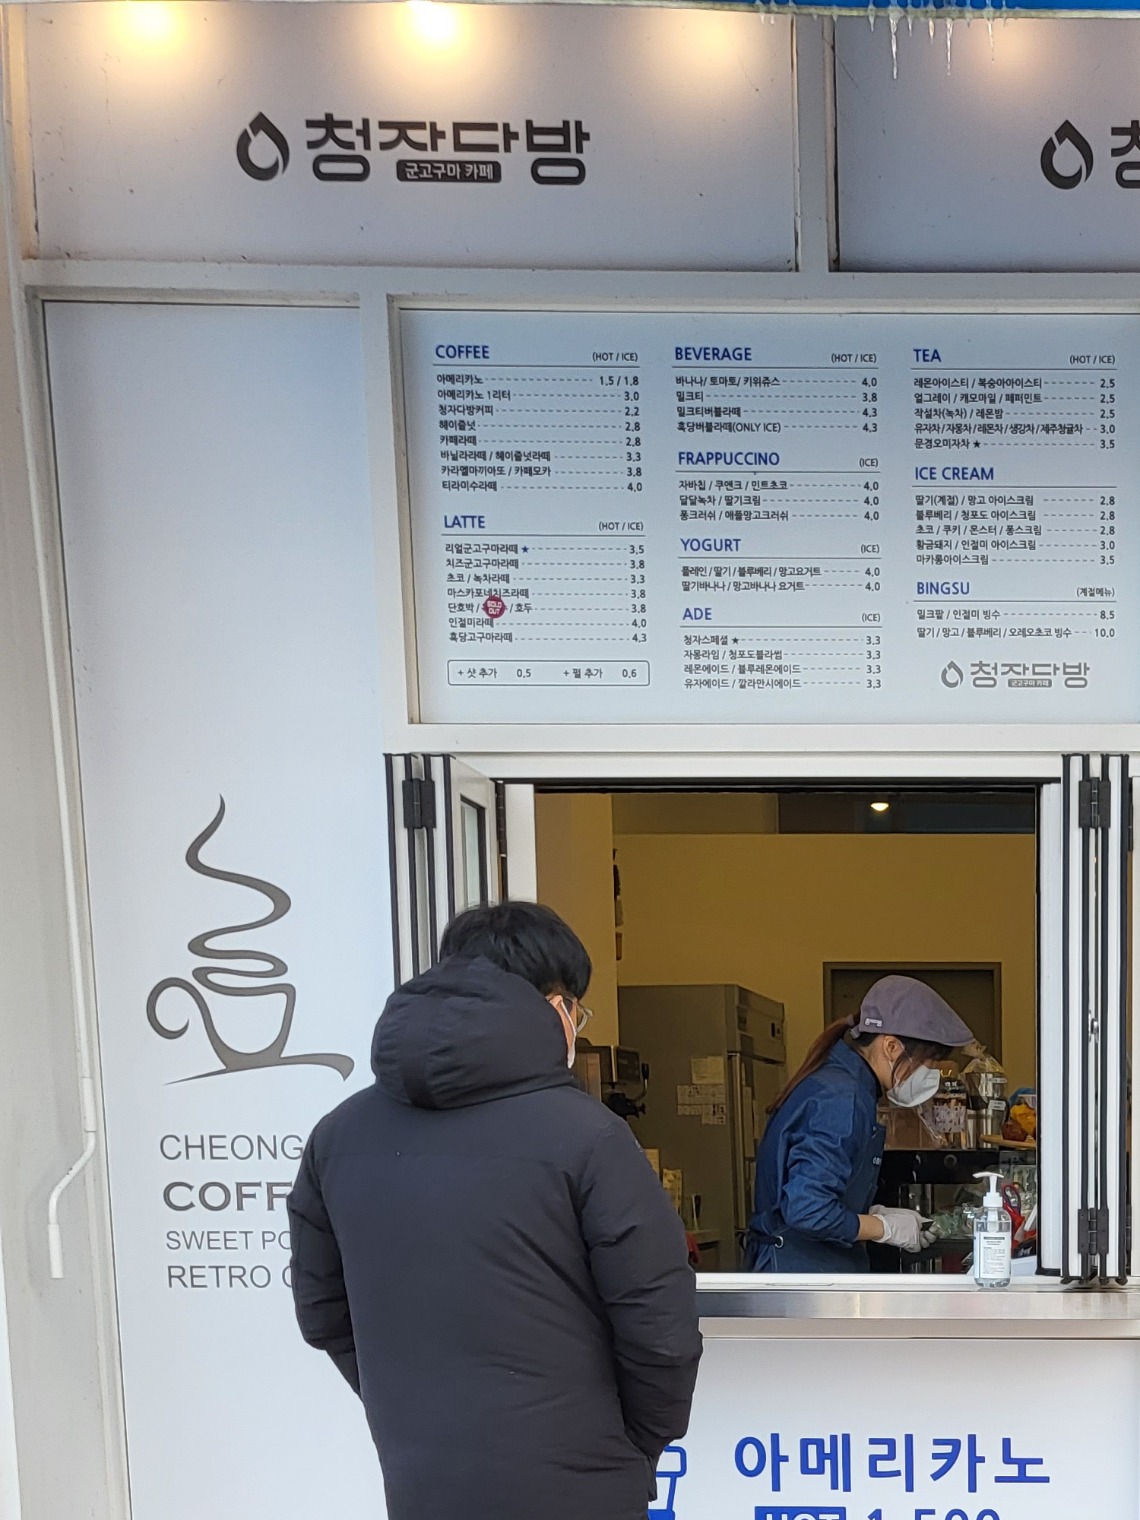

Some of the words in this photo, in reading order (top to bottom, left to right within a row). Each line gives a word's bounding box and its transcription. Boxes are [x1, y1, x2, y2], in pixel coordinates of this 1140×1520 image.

[304, 113, 590, 186] 청자다방
[404, 163, 461, 180] 군고구마
[464, 163, 494, 181] 카페
[435, 345, 489, 359] COFFEE
[675, 347, 752, 361] BEVERAGE
[913, 348, 941, 362] TEA
[436, 374, 483, 385] 아메리카노
[599, 376, 614, 386] 1.5
[624, 376, 639, 386] 1.8
[914, 378, 968, 388] 레몬아이스티
[978, 378, 1042, 388] 복숭아아이스티
[1100, 378, 1115, 389] 2.5
[437, 389, 483, 400] 아메리카노
[487, 389, 510, 401] 1리터
[624, 391, 639, 401] 3.0
[676, 391, 704, 402] 밀크티
[862, 393, 877, 403] 3.8
[914, 393, 950, 404] 얼그레이
[959, 393, 996, 404] 캐모마일
[1005, 393, 1042, 404] 페퍼민트
[1100, 394, 1115, 404] 2.5
[438, 405, 493, 415] 청자다방커피
[624, 407, 639, 416] 2.2
[676, 406, 741, 418] 밀크티버블라떼
[862, 408, 877, 418] 4.3
[625, 422, 640, 432] 2.8
[439, 435, 476, 446] 카페라떼
[625, 437, 641, 447] 2.8
[915, 438, 969, 449] 문경오미자차
[1100, 439, 1115, 449] 3.5
[440, 450, 486, 461] 바닐라라떼
[626, 452, 641, 462] 3.3
[678, 451, 779, 465] FRAPPUCCINO
[859, 457, 878, 468] (ICE)
[915, 467, 936, 480] ICE
[942, 467, 994, 480] CREAM
[441, 480, 497, 491] 티라미수라떼
[627, 482, 642, 492] 4.0
[678, 480, 706, 491] 자바칩
[714, 481, 742, 490] 쿠앤크
[751, 480, 788, 490] 민트초코
[863, 481, 879, 491] 4.0
[679, 495, 716, 506] 달달녹차
[724, 495, 761, 506] 딸기크림
[863, 496, 879, 506] 4.0
[679, 510, 716, 521] 퐁크러쉬
[724, 510, 788, 521] 애플망고크러쉬
[864, 511, 879, 521] 4.0
[444, 515, 485, 529] LATTE
[915, 525, 934, 535] 초코
[942, 525, 960, 536] 쿠키
[969, 525, 997, 536] 몬스터
[1005, 525, 1041, 536] 퐁스크림
[1100, 526, 1115, 536] 2.8
[445, 543, 518, 554] 리얼군고구마라떼
[629, 545, 644, 555] 3.5
[680, 538, 741, 551] YOGURT
[860, 544, 879, 554] (ICE)
[445, 558, 518, 569] 치즈군고구마라떼
[629, 560, 645, 569] 3.8
[916, 555, 988, 565] 마카롱아이스크림
[1100, 555, 1115, 565] 3.5
[446, 573, 465, 583] 초코
[473, 573, 510, 584] 녹차라떼
[630, 575, 645, 584] 3.3
[681, 581, 725, 592] 딸기바나나
[732, 581, 776, 592] 망고바나나
[778, 581, 805, 591] 요거트
[865, 582, 880, 592] 4.0
[916, 582, 970, 595] BINGSU
[1076, 587, 1115, 597] (계절메뉴)
[448, 602, 474, 613] 단호박
[514, 603, 532, 613] 호두
[631, 604, 646, 614] 3.8
[488, 607, 500, 615] OUT
[682, 607, 712, 620] ADE
[861, 613, 880, 622] (ICE)
[952, 609, 979, 620] 인절미
[982, 609, 1001, 620] 빙수
[1100, 610, 1114, 620] 8.5
[448, 617, 494, 628] 인절미라떼
[631, 619, 647, 628] 4.0
[631, 633, 647, 643] 4.3
[683, 635, 728, 645] 청자스페셜
[866, 636, 881, 645] 3.3
[684, 664, 729, 674] 레몬에이드
[737, 664, 801, 674] 블루레몬에이드
[866, 665, 881, 674] 3.3
[970, 660, 1090, 688] 청자다방
[165, 1230, 253, 1250] SWEET
[167, 1265, 271, 1288] RETRO
[734, 1433, 1050, 1492] 아메리카노
